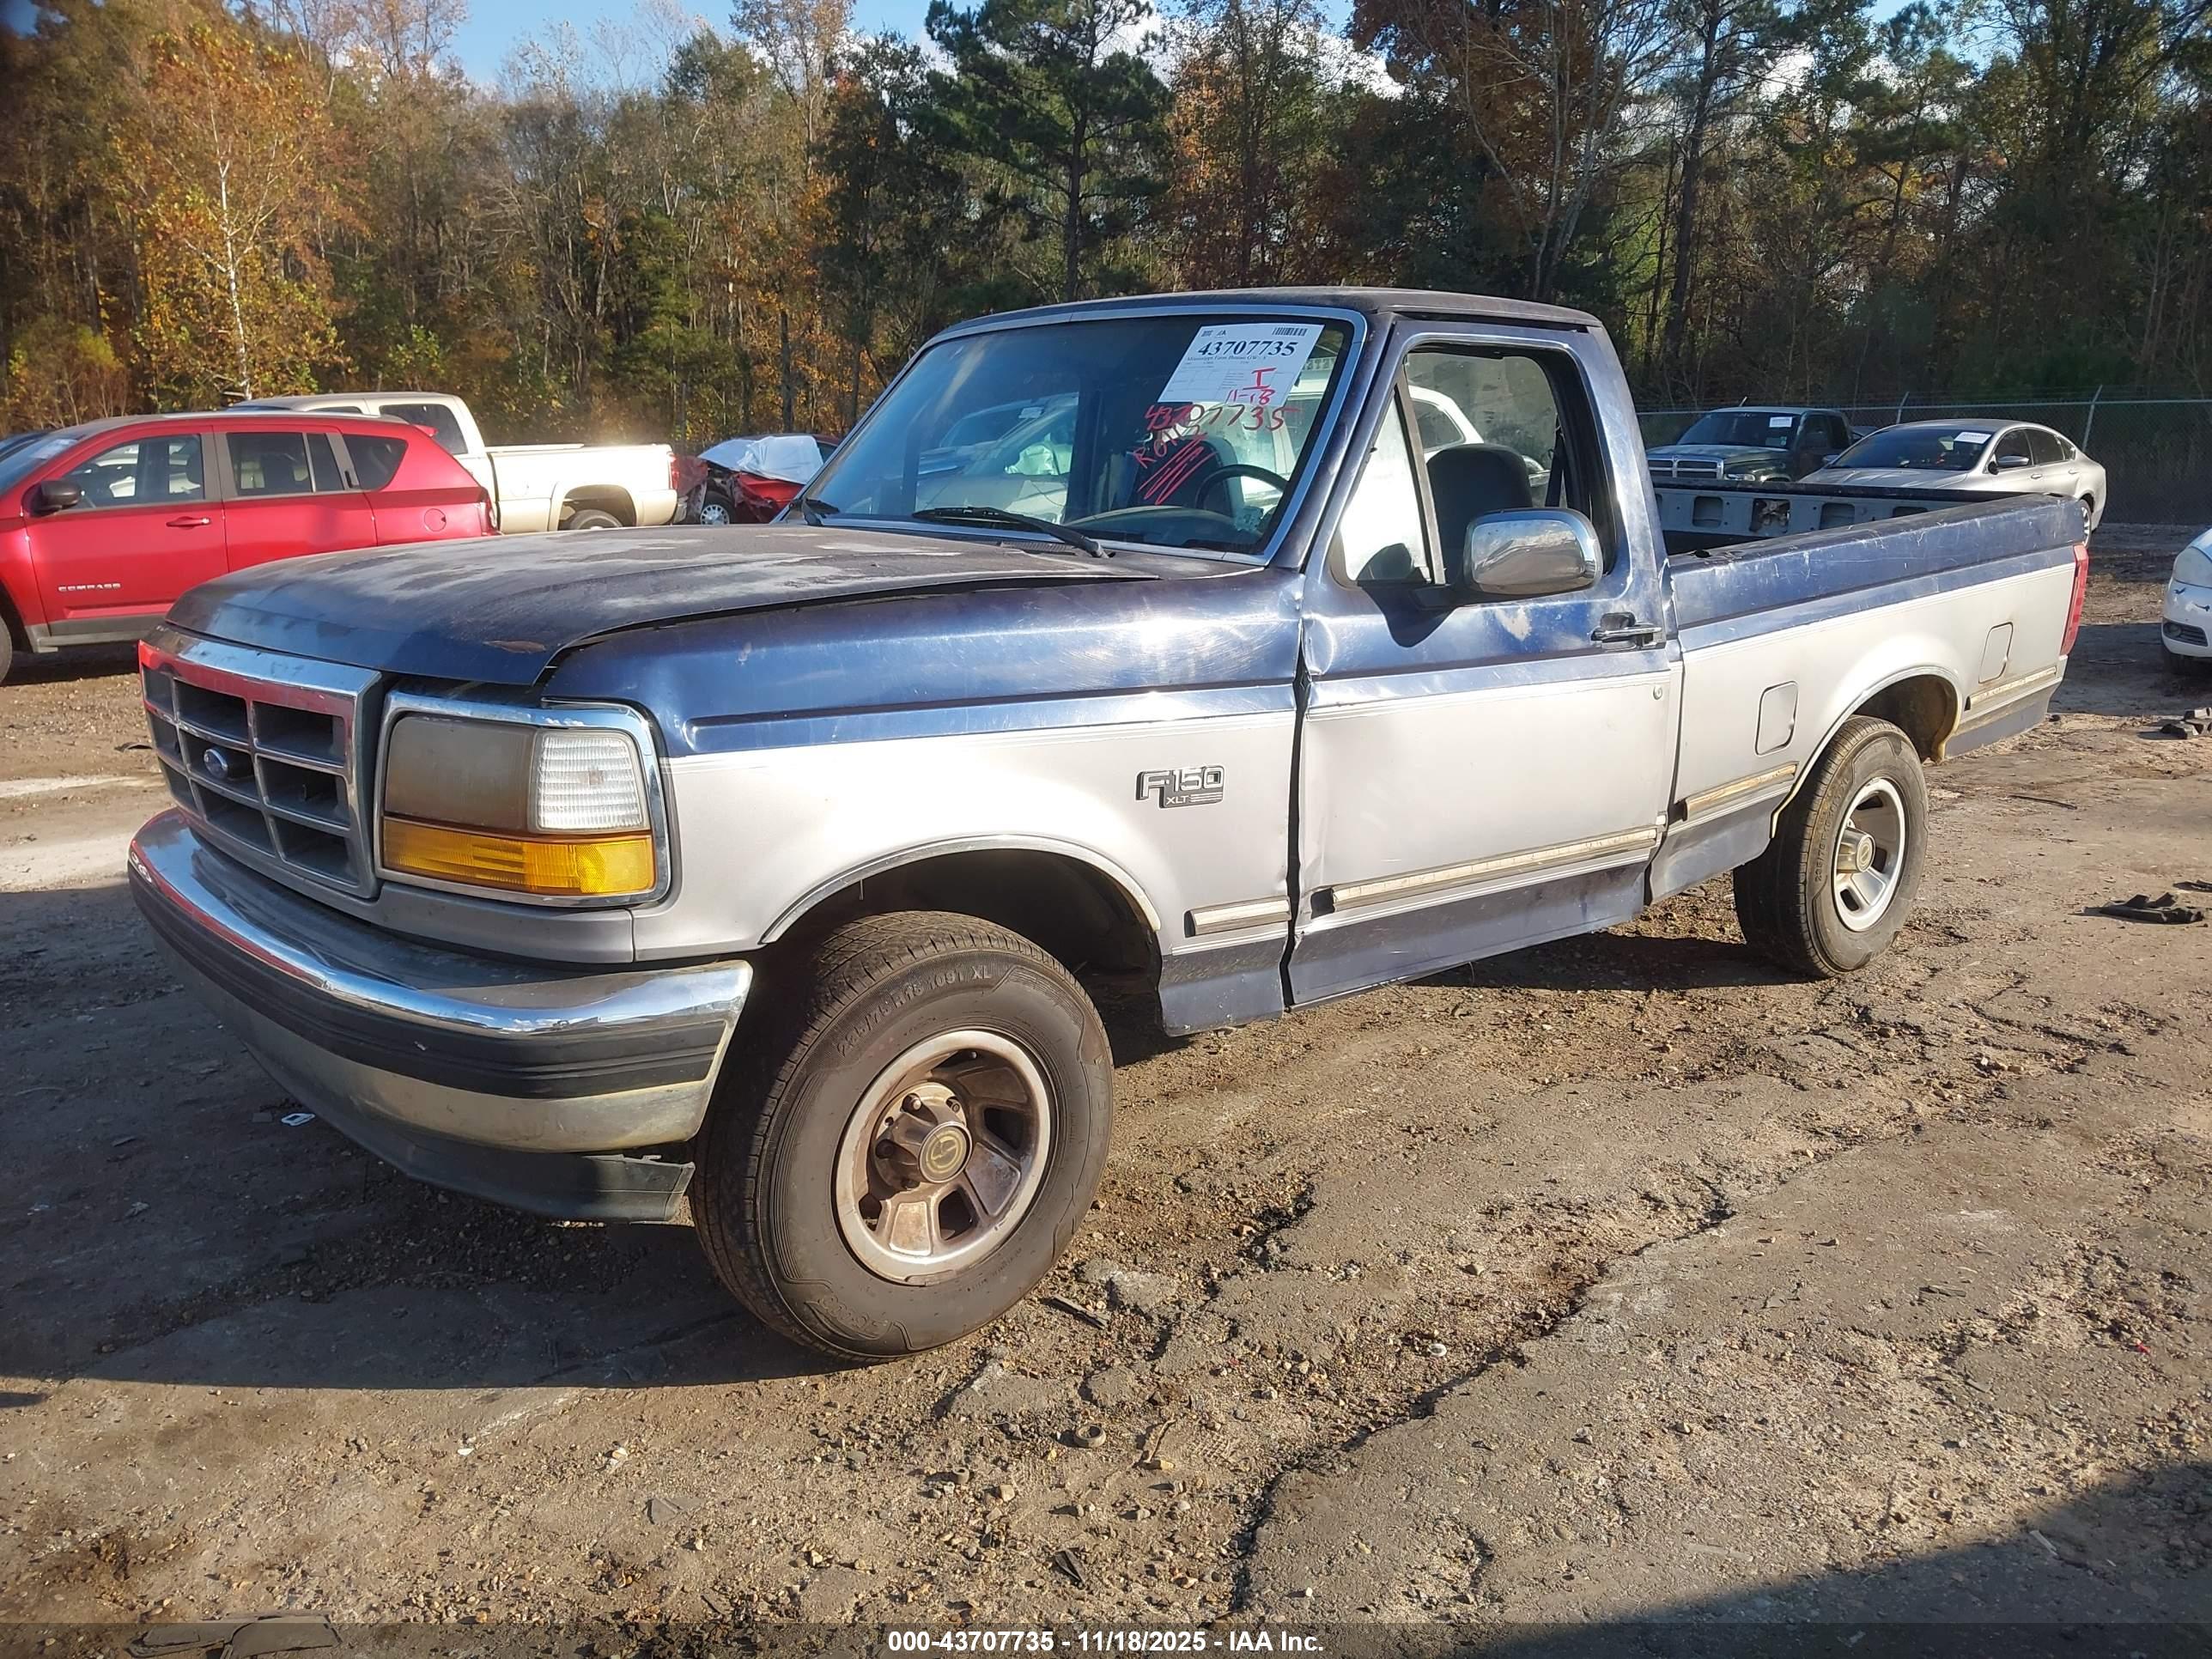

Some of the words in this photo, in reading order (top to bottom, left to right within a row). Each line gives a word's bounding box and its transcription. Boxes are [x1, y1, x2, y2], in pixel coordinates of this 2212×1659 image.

[1198, 340, 1298, 356] 43707735
[1166, 795, 1189, 805] XLT
[971, 964, 993, 981] XL
